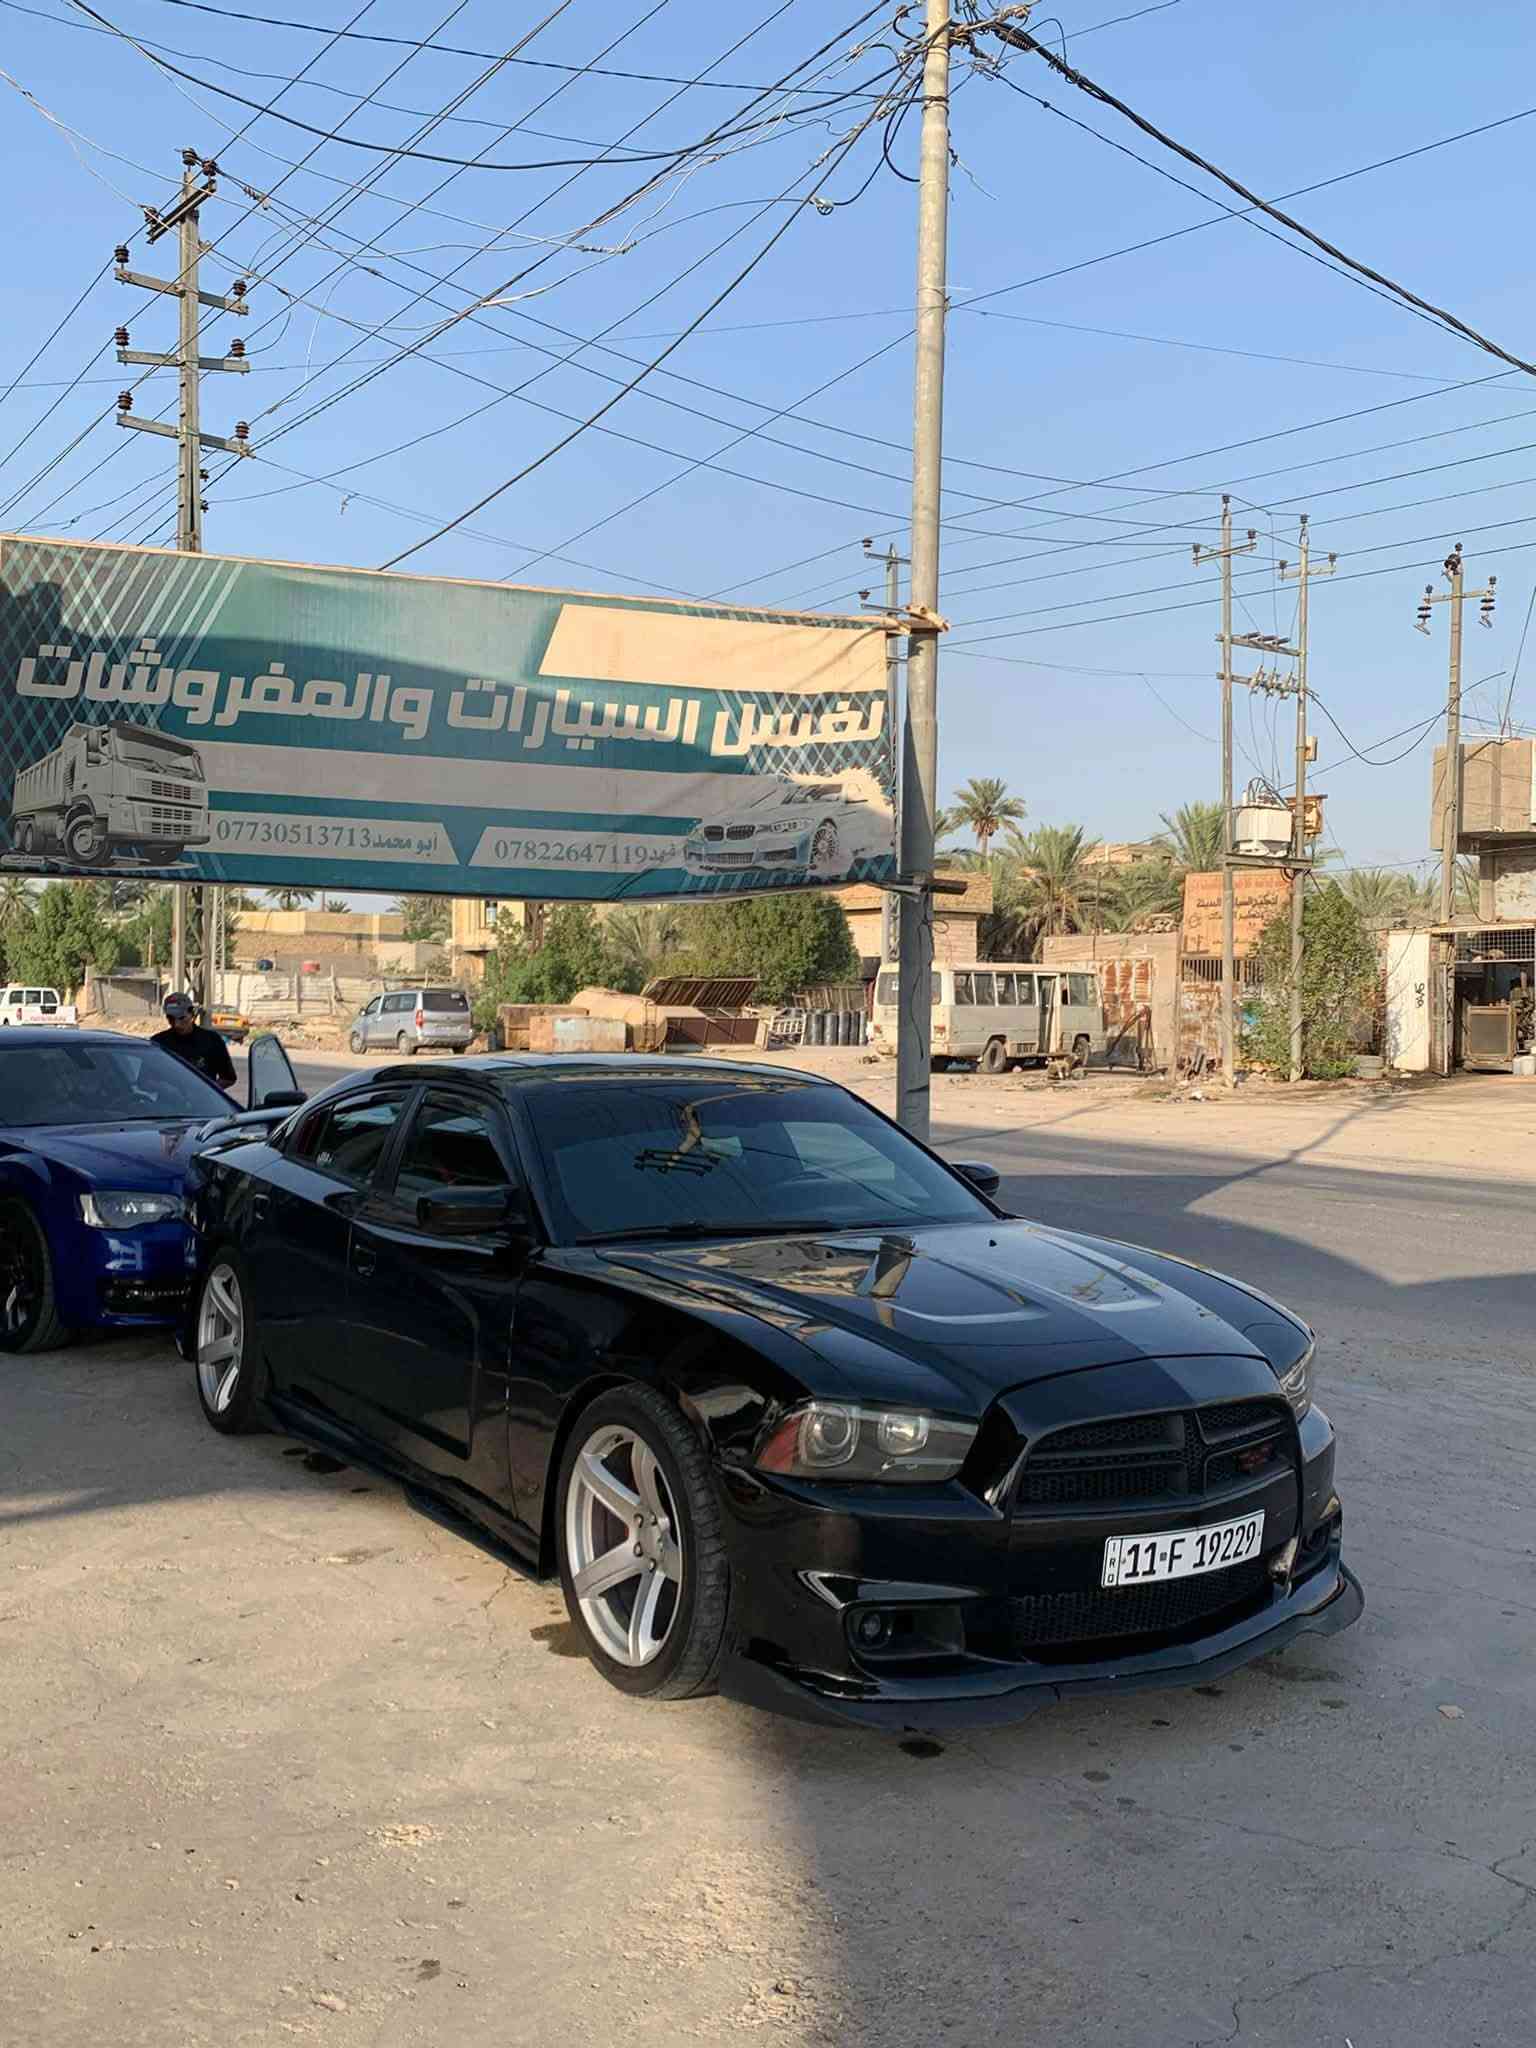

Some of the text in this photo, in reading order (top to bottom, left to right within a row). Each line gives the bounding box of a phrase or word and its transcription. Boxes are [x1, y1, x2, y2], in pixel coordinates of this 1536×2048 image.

[16, 638, 433, 740] والمفروشات
[447, 679, 700, 750] السيارات
[216, 819, 371, 848] 07730513713
[494, 839, 648, 865] 07822647119
[1125, 1542, 1157, 1578] 11
[1168, 1538, 1186, 1573] F
[1193, 1521, 1256, 1568] 19229
